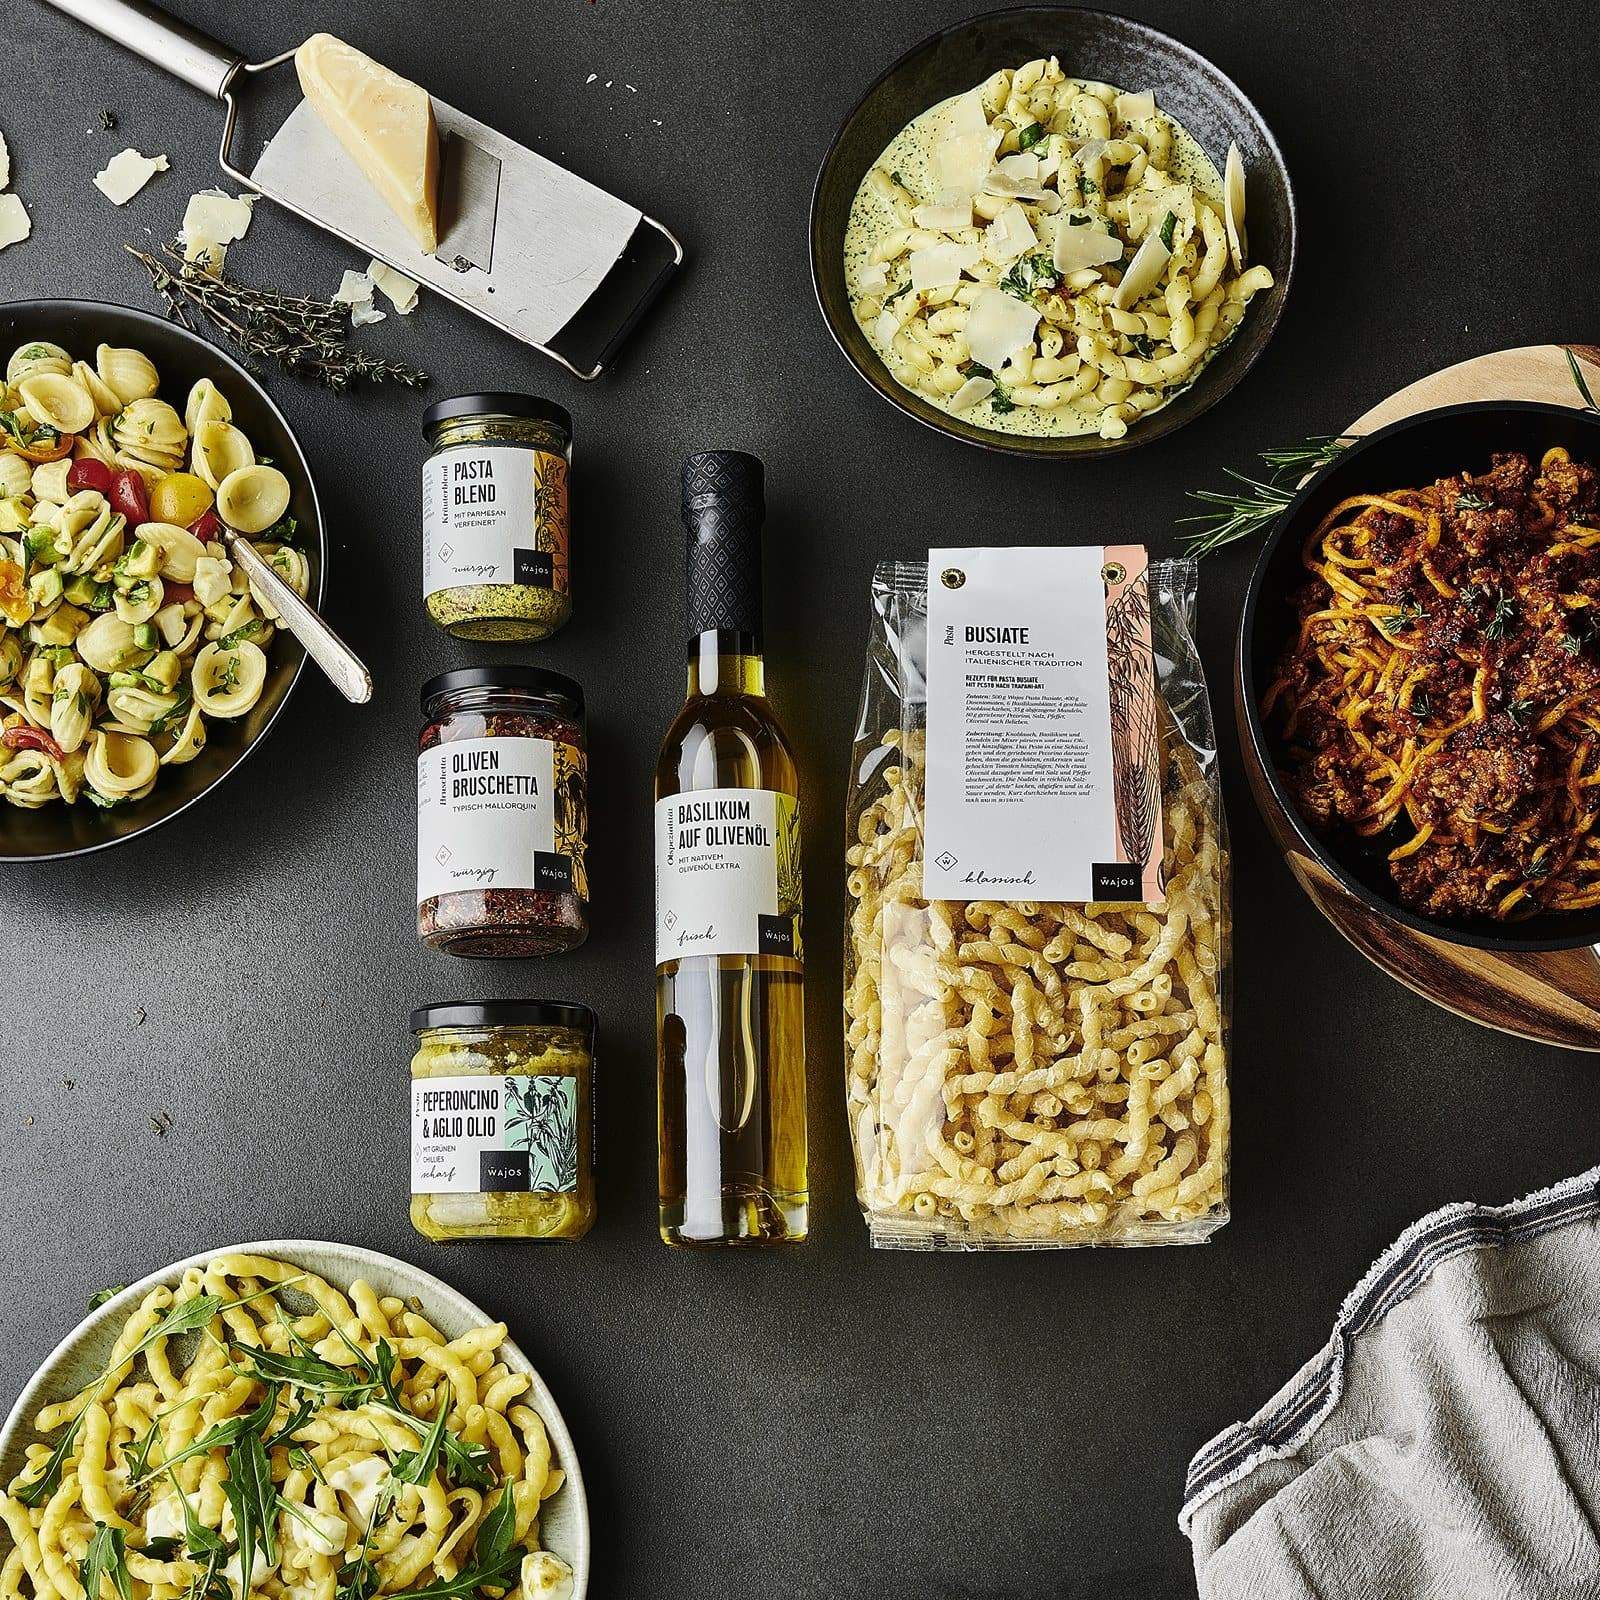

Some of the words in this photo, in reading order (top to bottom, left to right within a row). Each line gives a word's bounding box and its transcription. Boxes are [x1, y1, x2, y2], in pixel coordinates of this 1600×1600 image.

[455, 460, 493, 481] PASTA
[455, 485, 495, 505] BLEND
[455, 520, 496, 528] VERFEINERT
[452, 565, 499, 577] würzig
[944, 625, 954, 645] Pasta
[966, 626, 1029, 644] BUSIATE
[966, 658, 1031, 666] ITALIENISCHER
[453, 751, 498, 773] OLIVEN
[453, 776, 538, 798] BRUSCHETTA
[453, 804, 482, 813] TYPISCH
[485, 803, 536, 811] MALLORQUIN
[679, 801, 750, 824] BASILIKUM
[679, 828, 701, 849] AUF
[706, 824, 770, 847] OLIVENÖL
[691, 854, 723, 862] NATIVEM
[450, 868, 499, 882] würzig
[679, 863, 714, 873] OLIVENÖL
[960, 871, 1037, 885] klassisch
[677, 925, 717, 946] frisch
[424, 1090, 498, 1111] PEPERONCINO
[423, 1118, 429, 1138] &
[433, 1117, 462, 1137] AGLIO
[467, 1116, 495, 1137] OLIO
[421, 1166, 456, 1181] scharf
